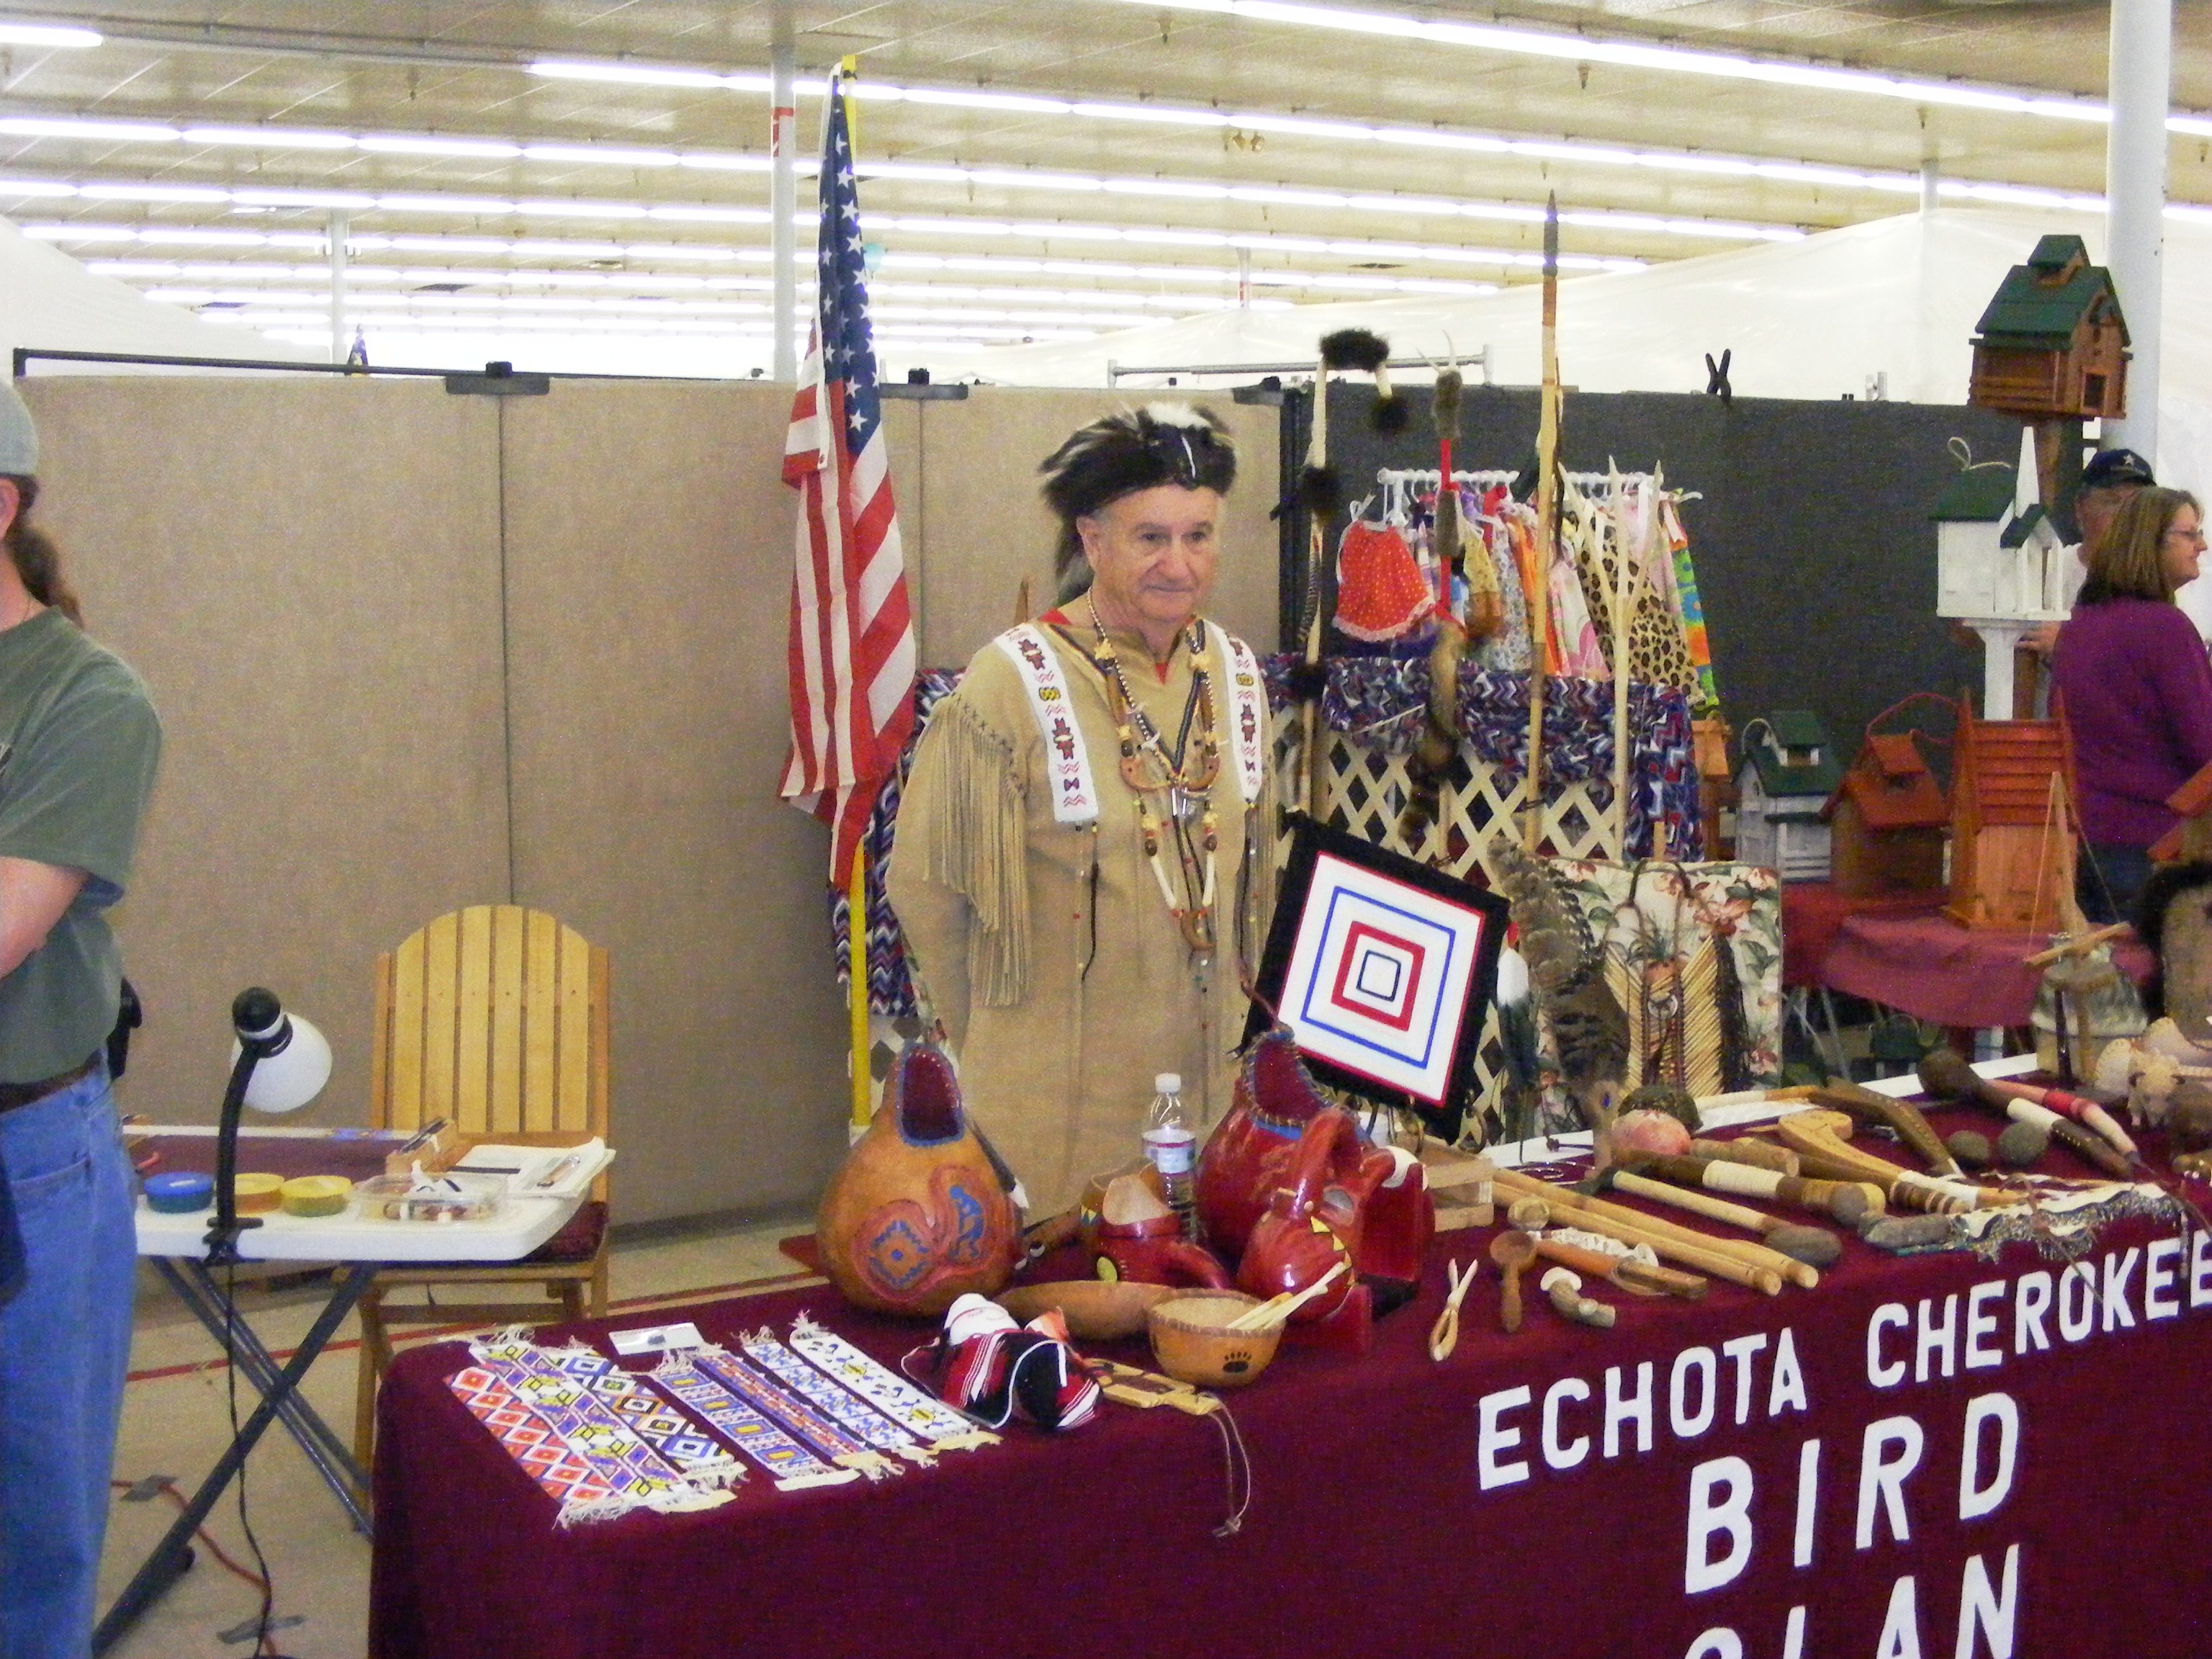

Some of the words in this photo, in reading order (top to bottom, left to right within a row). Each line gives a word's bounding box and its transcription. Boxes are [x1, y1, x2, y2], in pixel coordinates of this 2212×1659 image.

[1478, 1327, 1807, 1491] ECHOTA
[1866, 1230, 2212, 1389] CHEROKEE
[1684, 1391, 2020, 1594] BIRD
[1683, 1543, 2020, 1659] AN
